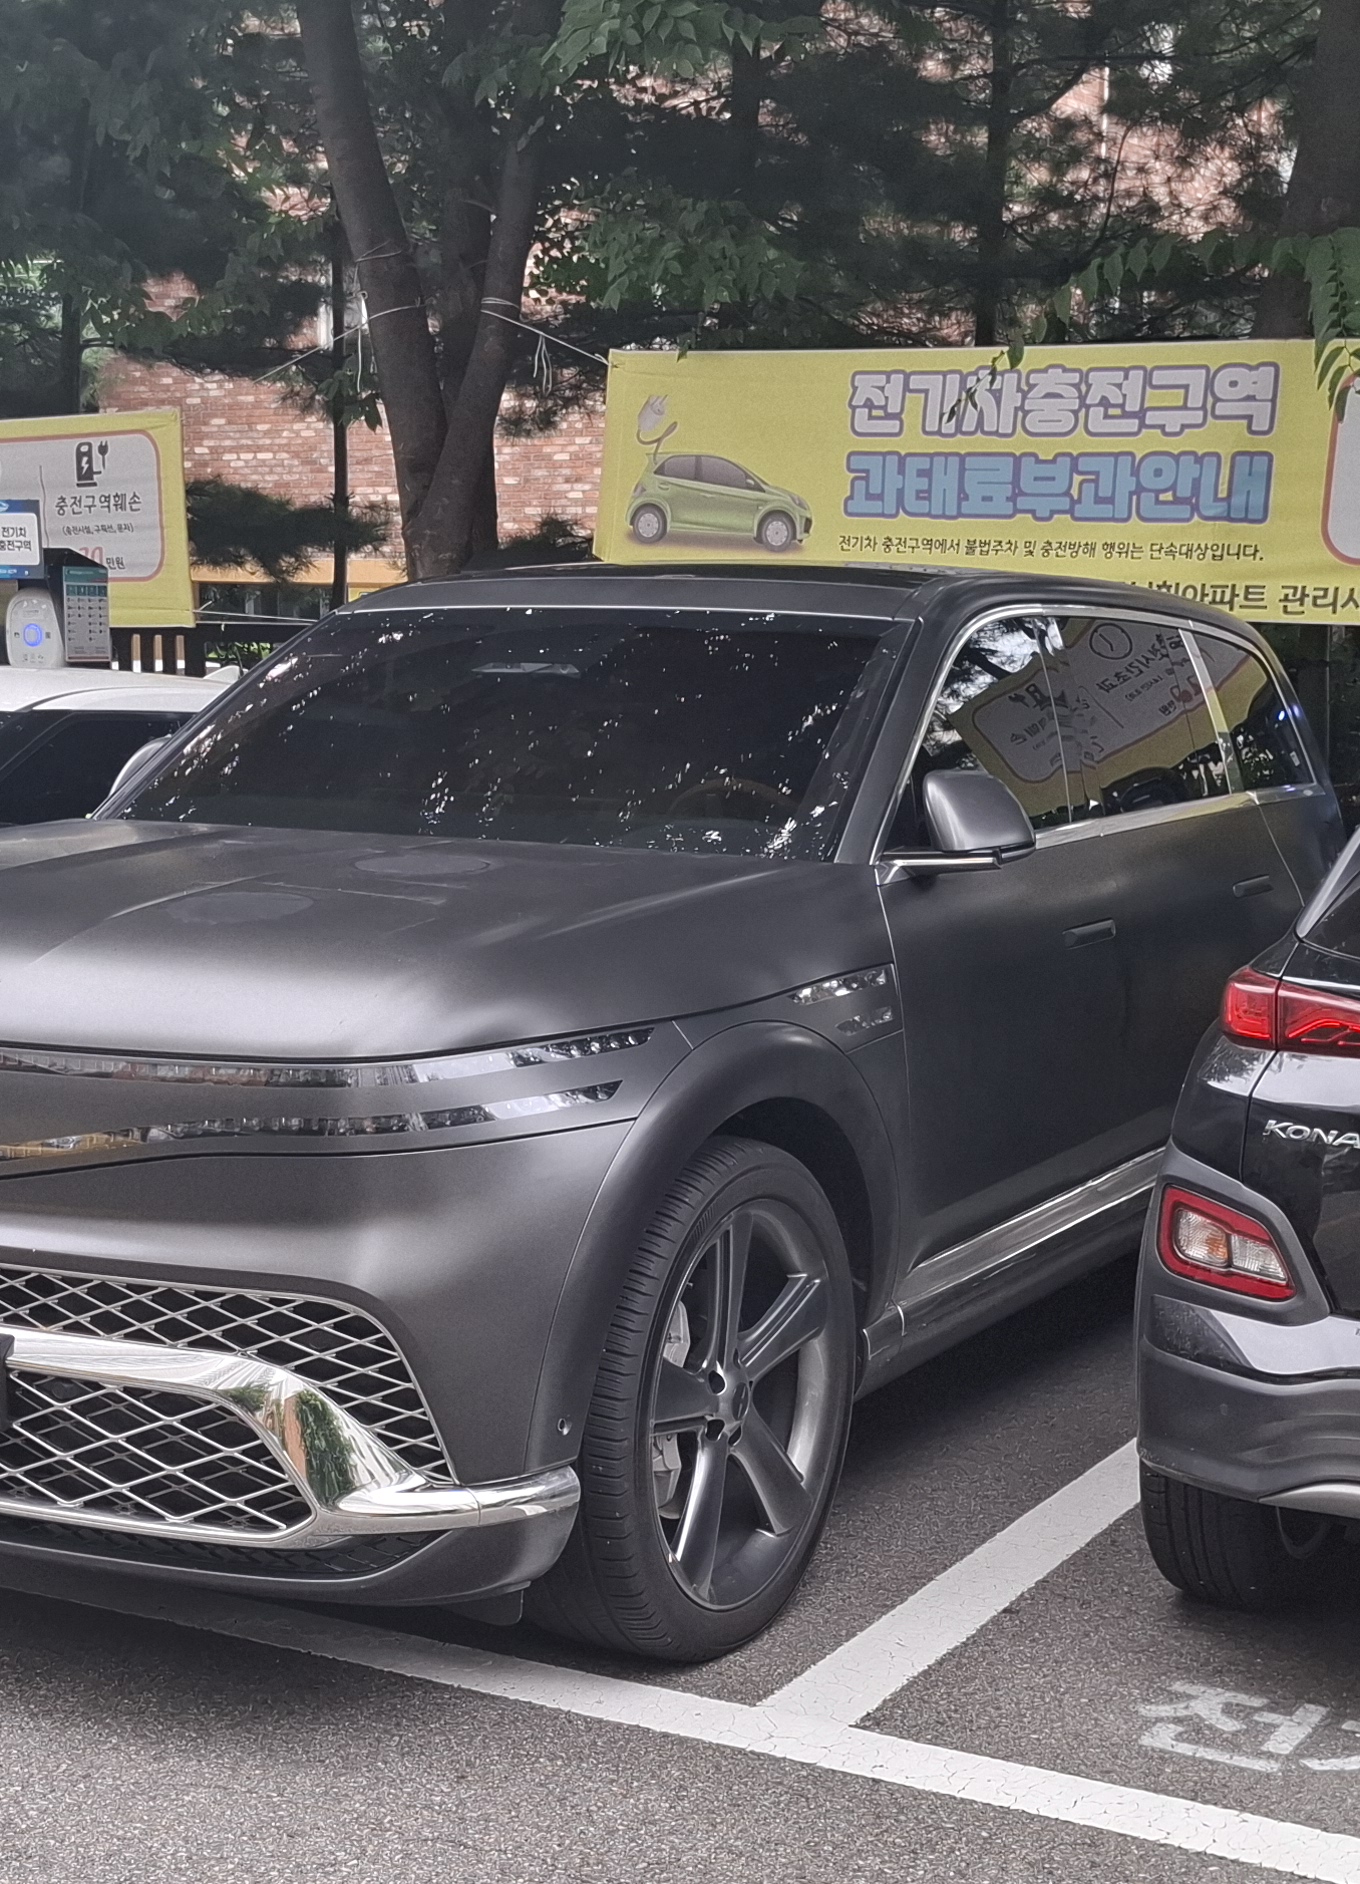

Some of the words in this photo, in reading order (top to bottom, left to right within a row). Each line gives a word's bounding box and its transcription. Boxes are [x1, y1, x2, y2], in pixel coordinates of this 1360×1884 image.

[849, 362, 1280, 438] 전기차충전구역
[844, 451, 1274, 524] 과태료부과안내
[55, 491, 142, 516] 충전구역훼손
[1, 526, 27, 538] 전기차
[838, 535, 878, 552] 전기차
[881, 536, 961, 554] 충전구역에서
[964, 538, 1019, 556] 불법주차
[1024, 540, 1036, 558] 및
[1041, 539, 1097, 559] 충전방해
[1102, 541, 1144, 560] 행위는
[1149, 541, 1264, 561] 단속대상입니다.
[106, 556, 126, 570] 만원
[1262, 1119, 1360, 1149] KONA
